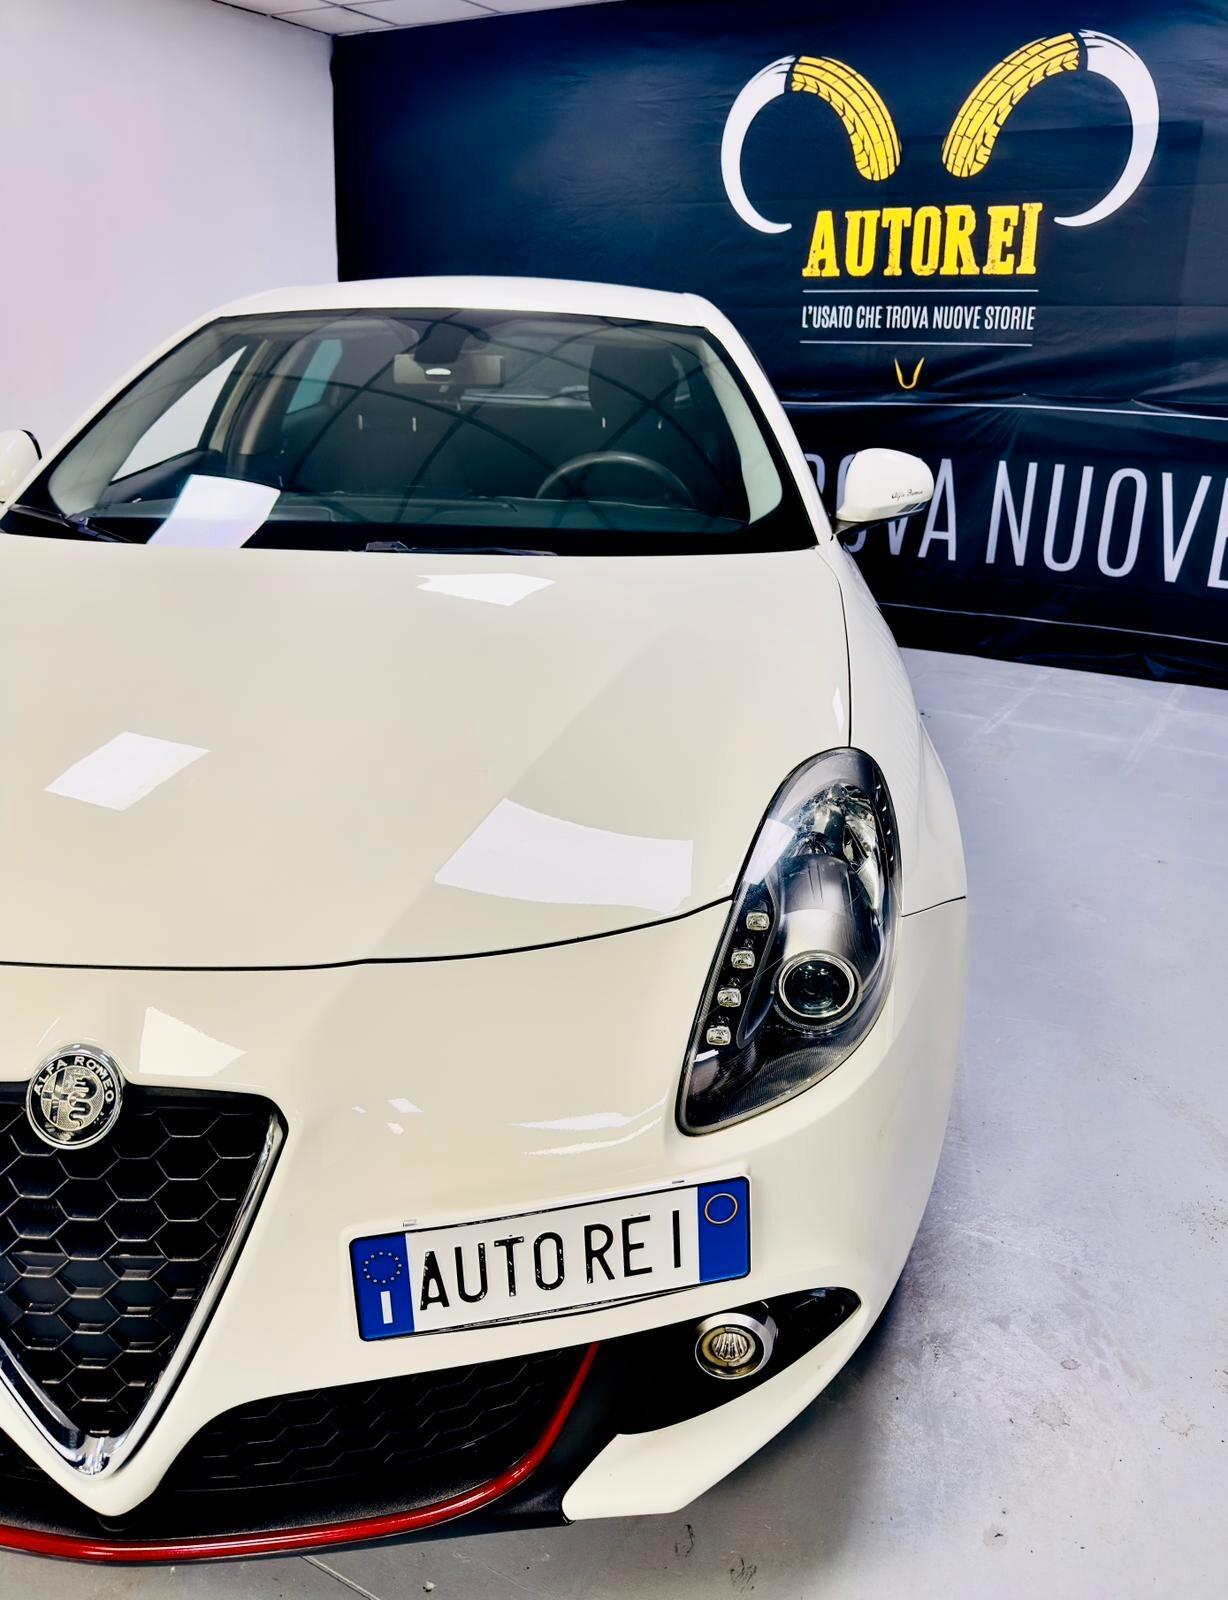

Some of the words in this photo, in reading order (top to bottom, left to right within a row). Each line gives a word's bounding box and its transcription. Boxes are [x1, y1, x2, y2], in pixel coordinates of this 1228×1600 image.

[801, 202, 1043, 277] AUTOREI
[802, 305, 852, 329] L'USATO
[856, 305, 883, 329] CHE
[885, 305, 929, 329] TROVA
[932, 305, 982, 330] NUOVE
[984, 306, 1037, 330] STORIE
[33, 1060, 68, 1096] ALFA
[73, 1055, 115, 1104] ROMEO
